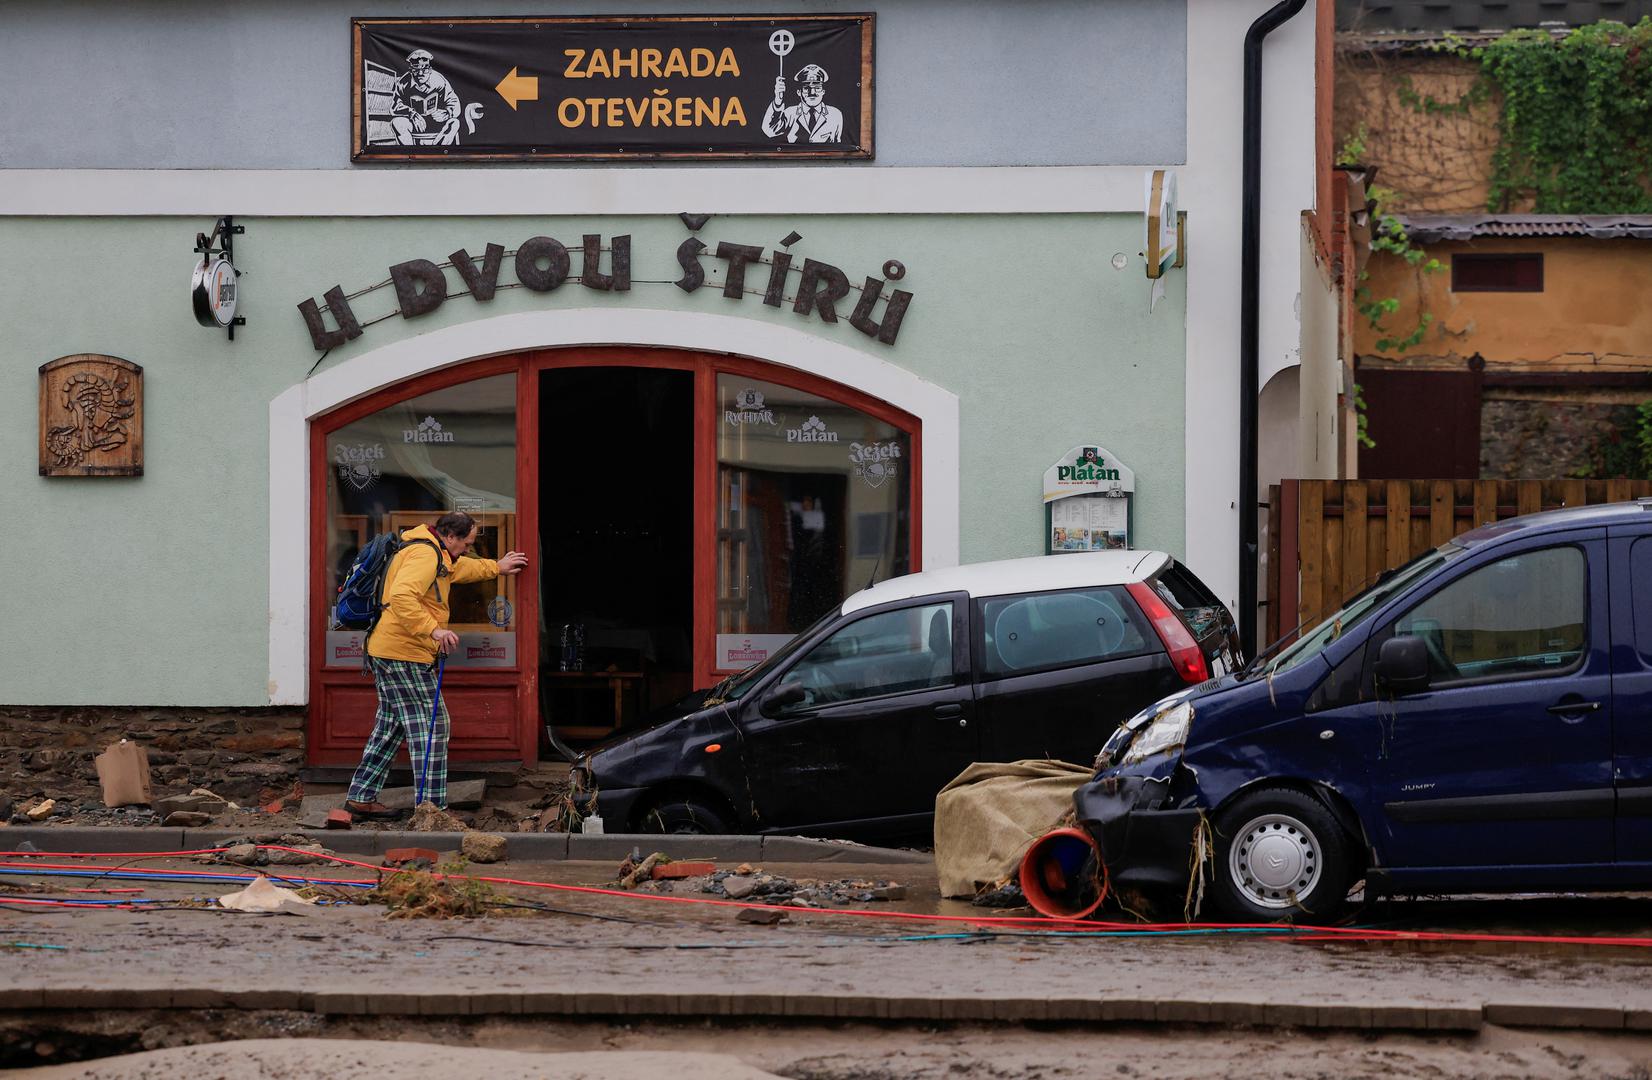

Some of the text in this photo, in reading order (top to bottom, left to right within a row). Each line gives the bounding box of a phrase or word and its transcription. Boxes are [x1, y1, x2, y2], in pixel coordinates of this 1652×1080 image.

[564, 47, 741, 79] ZAHRADA
[557, 88, 748, 128] OTEVŘENA
[297, 212, 914, 351] U DVOU ŠTÍRŮ
[403, 429, 454, 442] Platan
[787, 428, 838, 442] Platan
[336, 443, 385, 463] Ježek
[849, 442, 901, 463] Ježek
[1057, 465, 1120, 480] Platan
[1401, 783, 1436, 791] JUMPY
